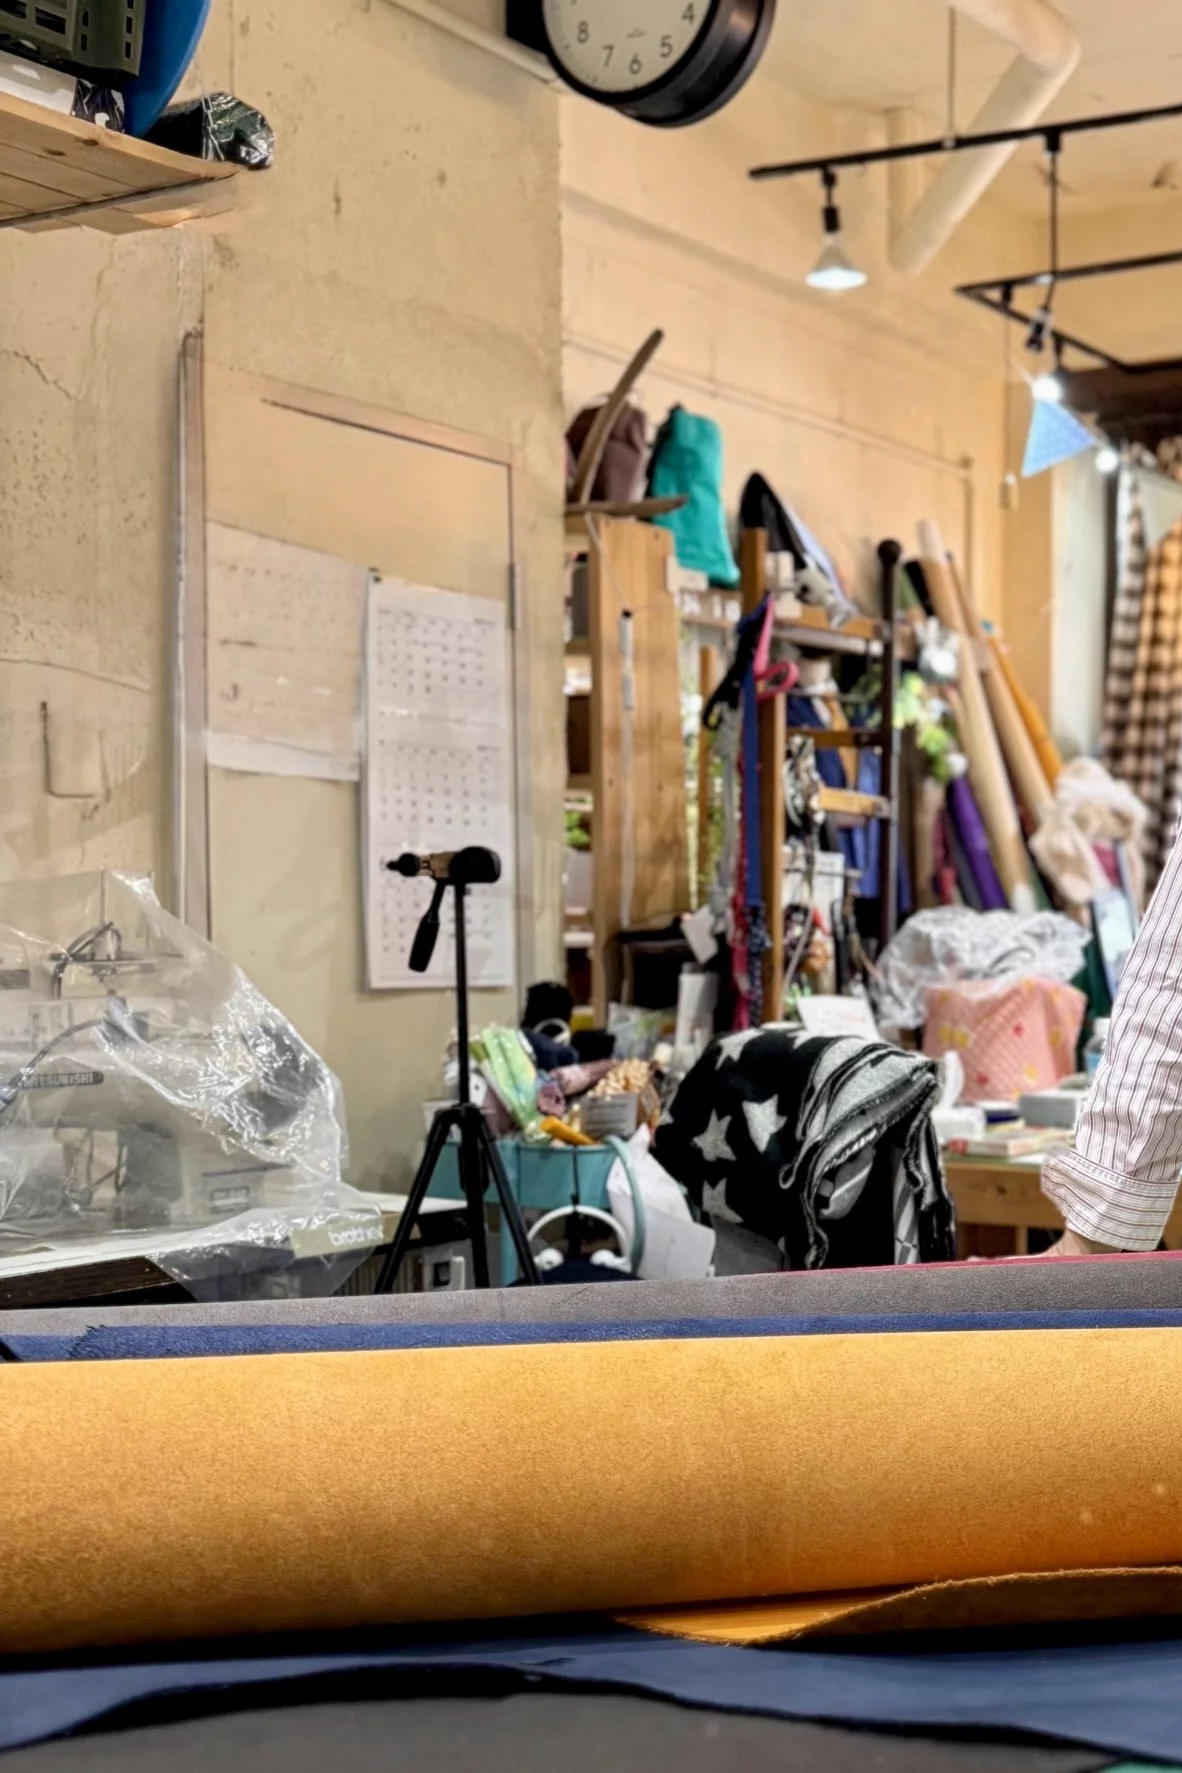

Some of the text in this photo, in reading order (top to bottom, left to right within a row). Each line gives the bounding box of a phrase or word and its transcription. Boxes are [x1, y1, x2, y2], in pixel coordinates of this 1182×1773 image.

[681, 2, 696, 24] 4
[577, 20, 589, 44] 8
[601, 44, 615, 67] 7
[659, 34, 673, 58] 5
[628, 52, 642, 75] 6
